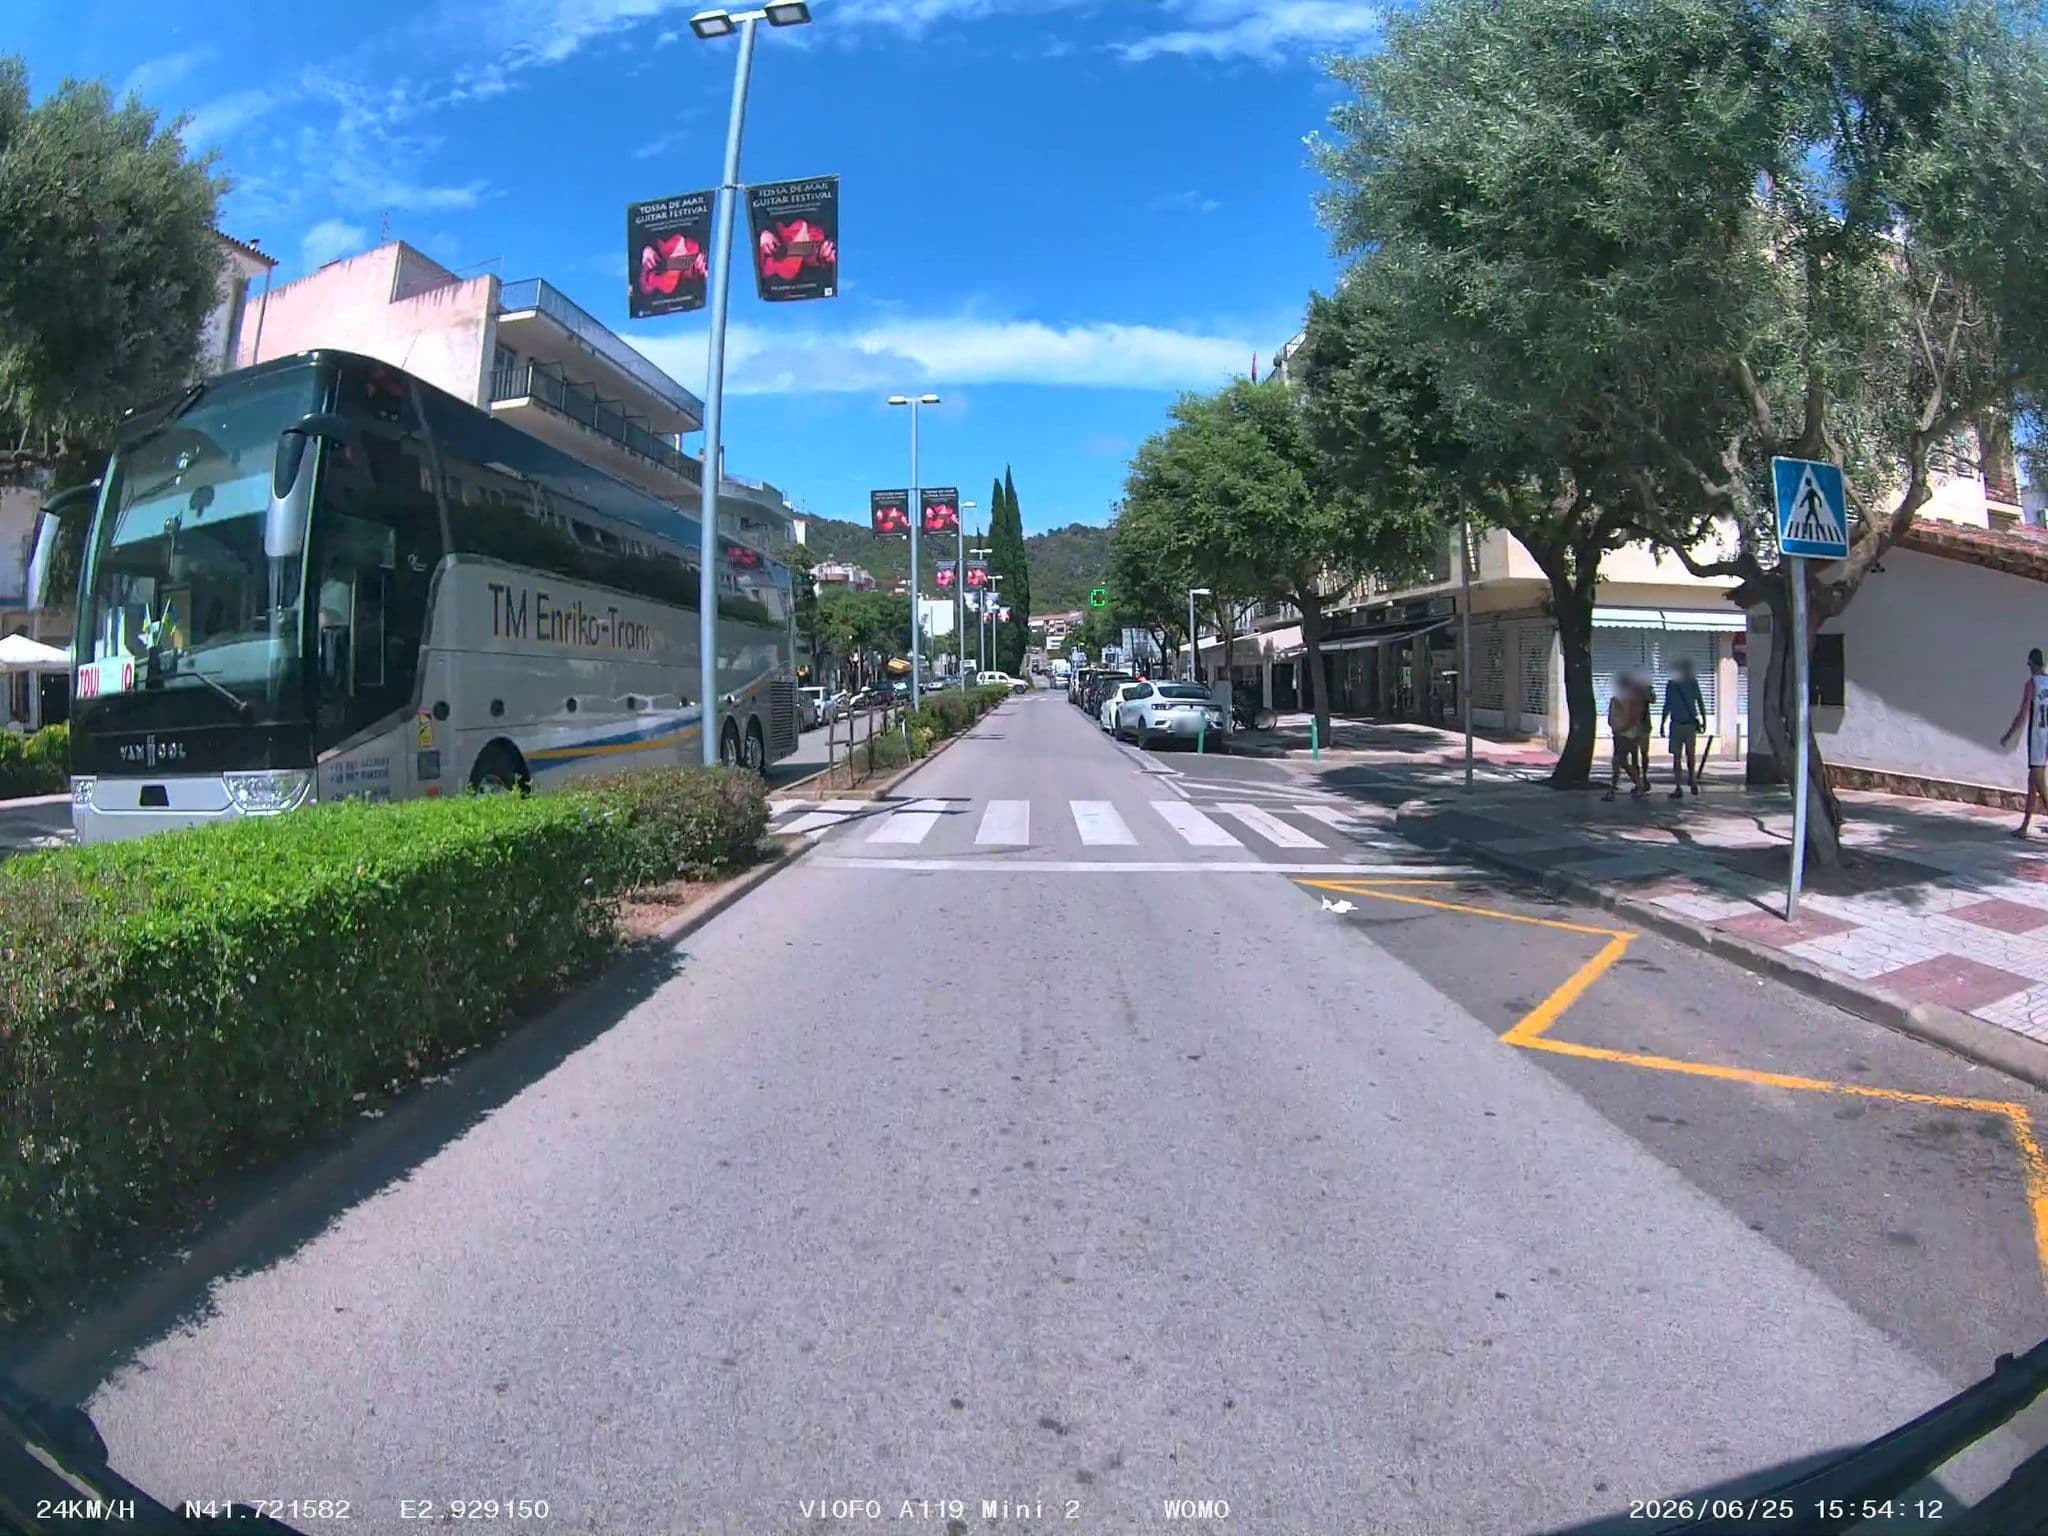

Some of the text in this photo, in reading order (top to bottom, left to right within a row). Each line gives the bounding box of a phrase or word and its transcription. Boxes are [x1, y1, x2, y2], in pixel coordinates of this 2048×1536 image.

[759, 187, 788, 197] TOSSA
[804, 182, 829, 191] MAR
[752, 191, 832, 207] GUITAR FESTIVAL
[639, 203, 668, 215] TOSSA
[635, 211, 668, 224] GUITAR
[487, 582, 652, 651] TM Enriko-Trans
